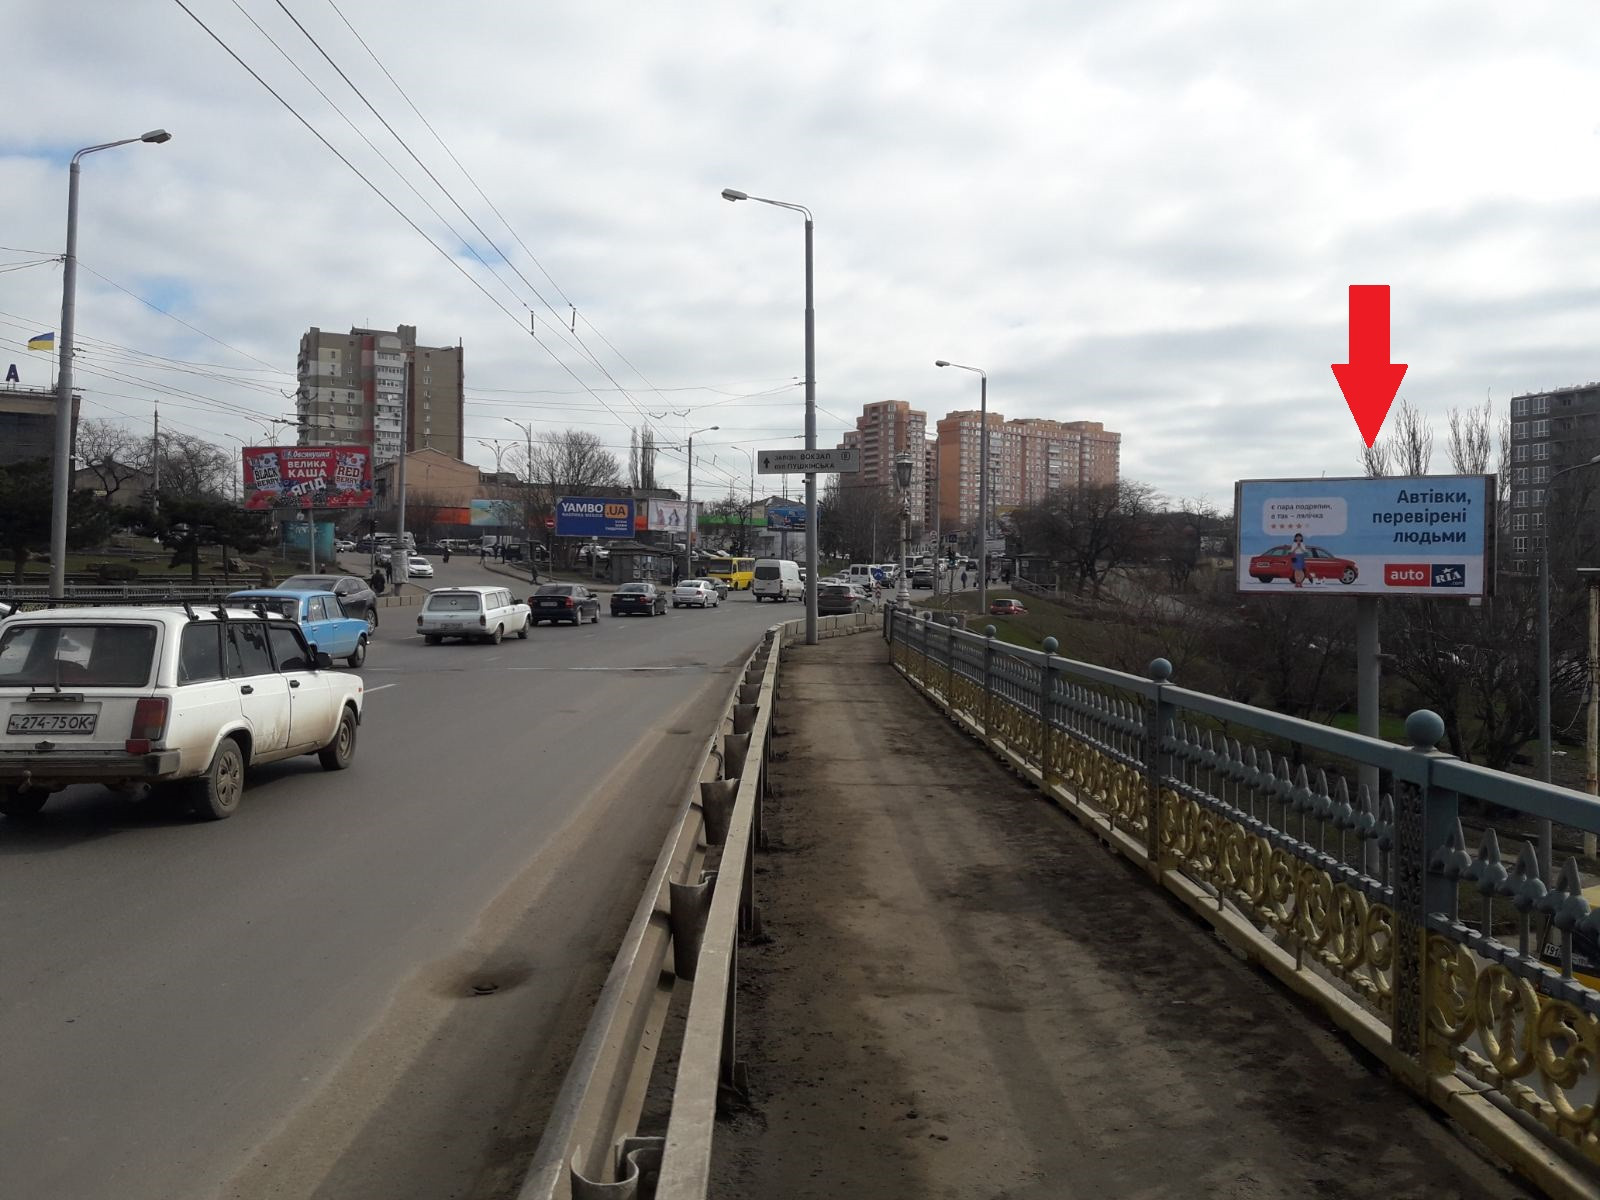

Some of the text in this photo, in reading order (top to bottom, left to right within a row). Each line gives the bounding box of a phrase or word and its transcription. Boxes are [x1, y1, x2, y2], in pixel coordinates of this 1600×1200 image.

[287, 460, 328, 468] ВЕЛИКА
[254, 467, 279, 480] BLACK
[288, 468, 328, 478] КАША
[337, 465, 360, 478] RED
[290, 478, 327, 496] ЯГІД
[1396, 488, 1472, 505] Автівки,
[1372, 508, 1467, 526] перевірені
[1393, 531, 1466, 545] людьми
[1390, 569, 1462, 584] auto RIA
